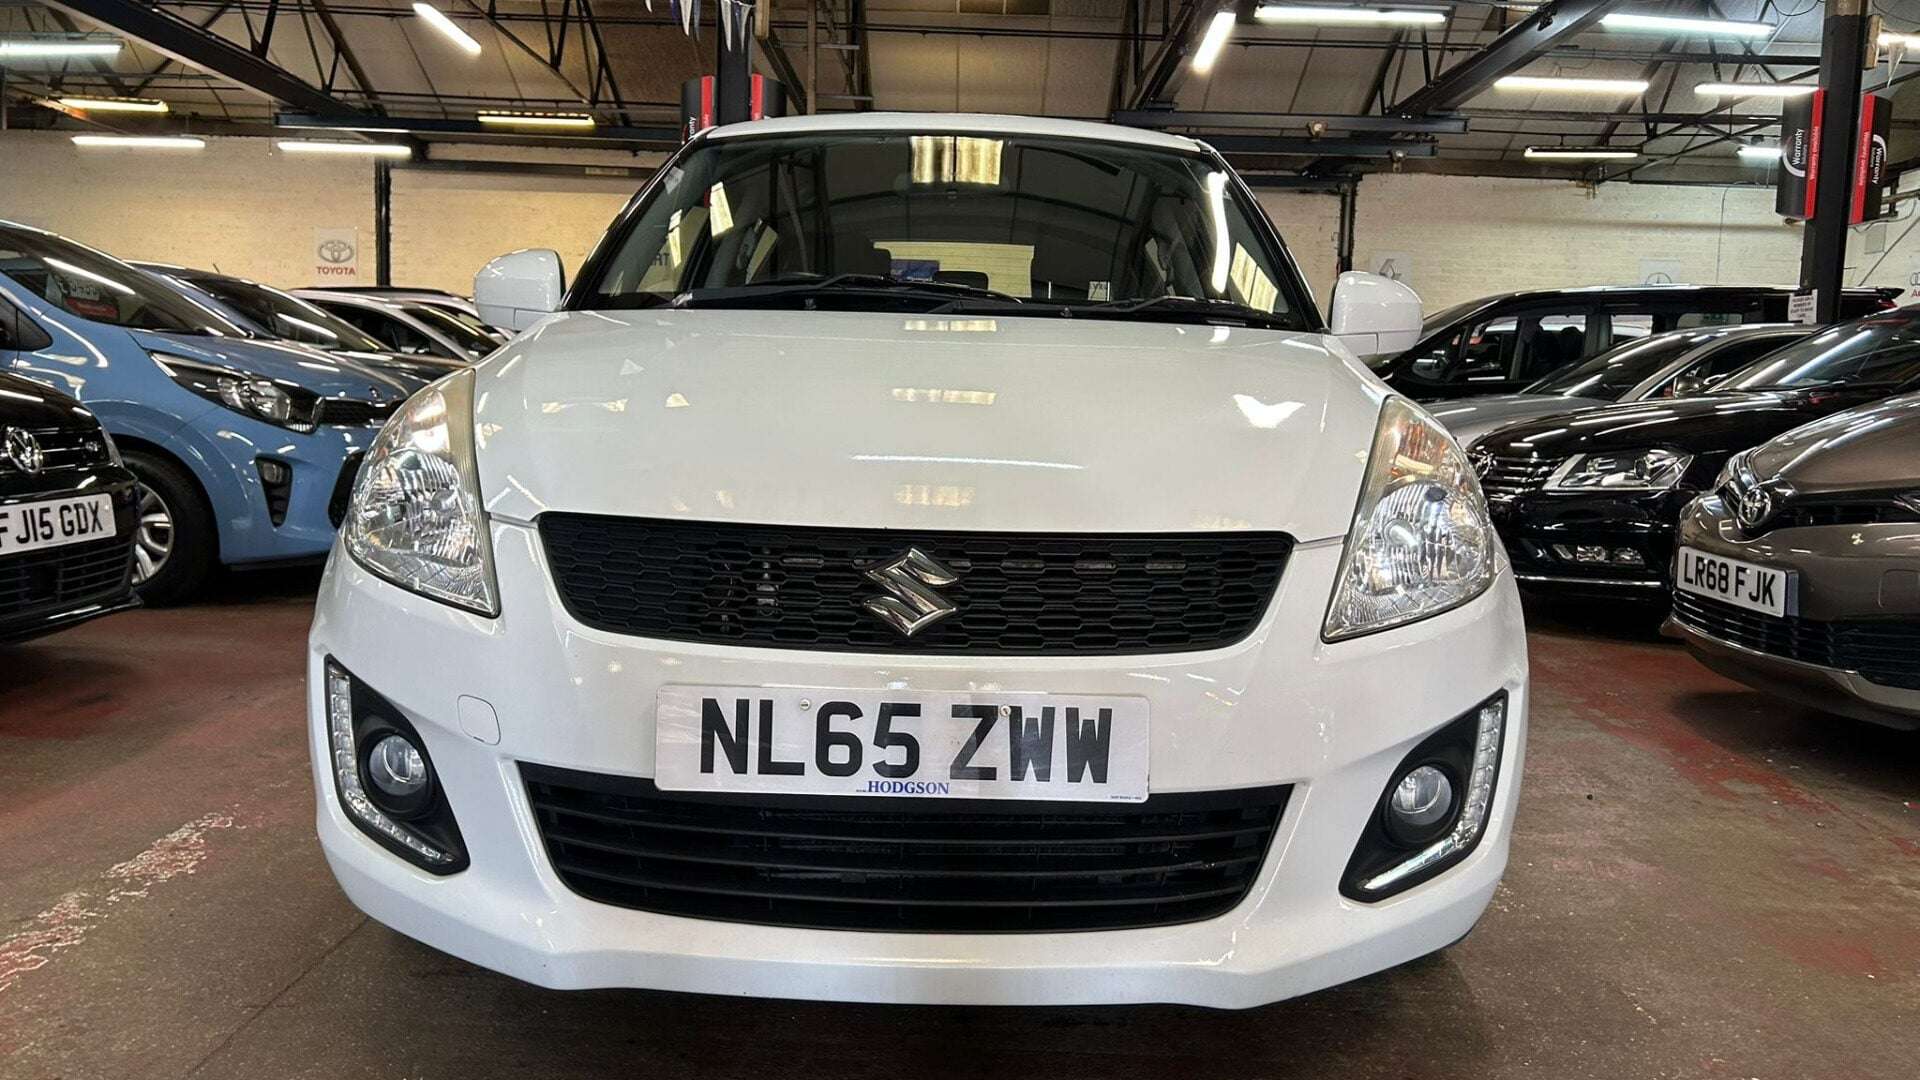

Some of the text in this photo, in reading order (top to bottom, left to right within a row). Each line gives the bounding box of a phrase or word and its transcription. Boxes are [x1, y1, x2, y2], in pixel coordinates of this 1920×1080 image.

[1791, 128, 1804, 165] Warranty
[1872, 147, 1883, 184] Warranty
[316, 266, 356, 276] TOYOTA
[59, 501, 104, 537] GDX
[1684, 553, 1776, 608] LR68 FJK
[700, 697, 1113, 784] NL65 ZWW
[868, 780, 950, 795] HODGSON
